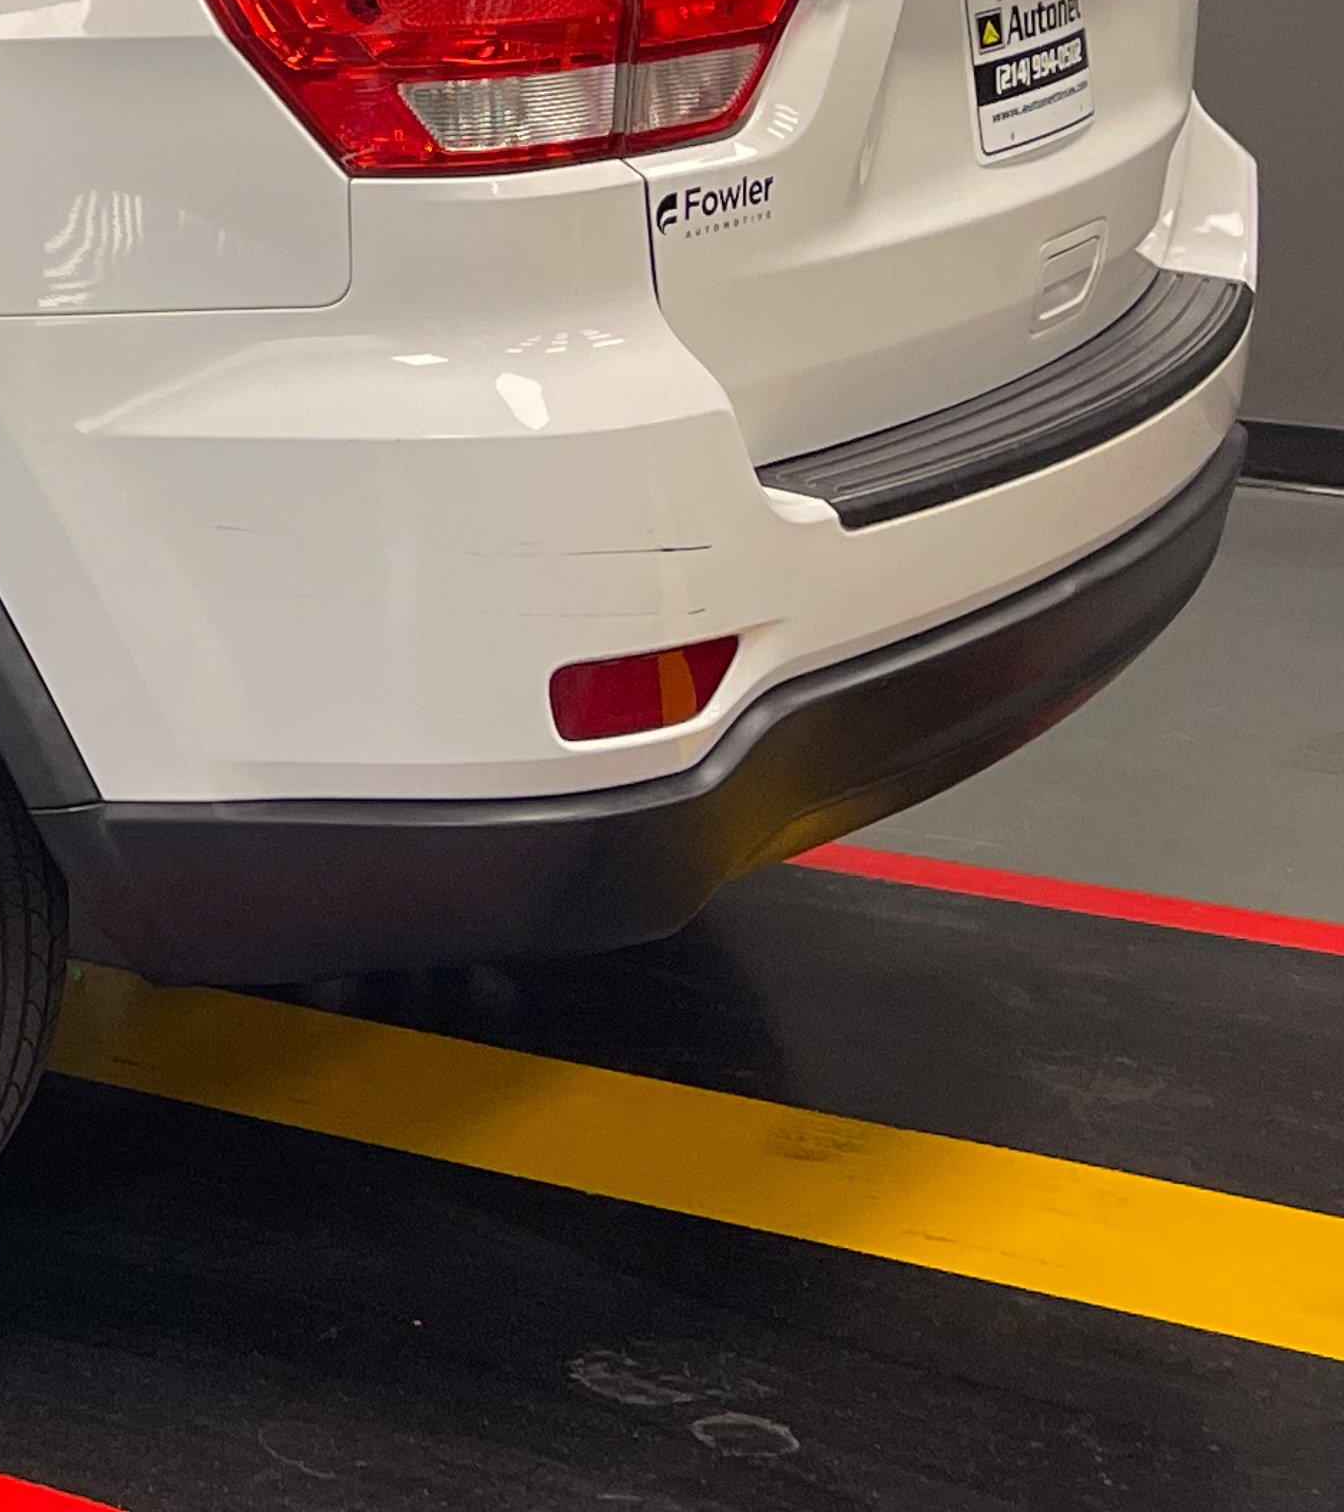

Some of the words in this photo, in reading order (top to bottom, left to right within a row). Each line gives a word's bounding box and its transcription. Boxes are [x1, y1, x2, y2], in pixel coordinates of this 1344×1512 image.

[996, 56, 1031, 95] (214)
[685, 176, 774, 220] Fowler
[685, 210, 772, 238] AUTOMOTIVE
